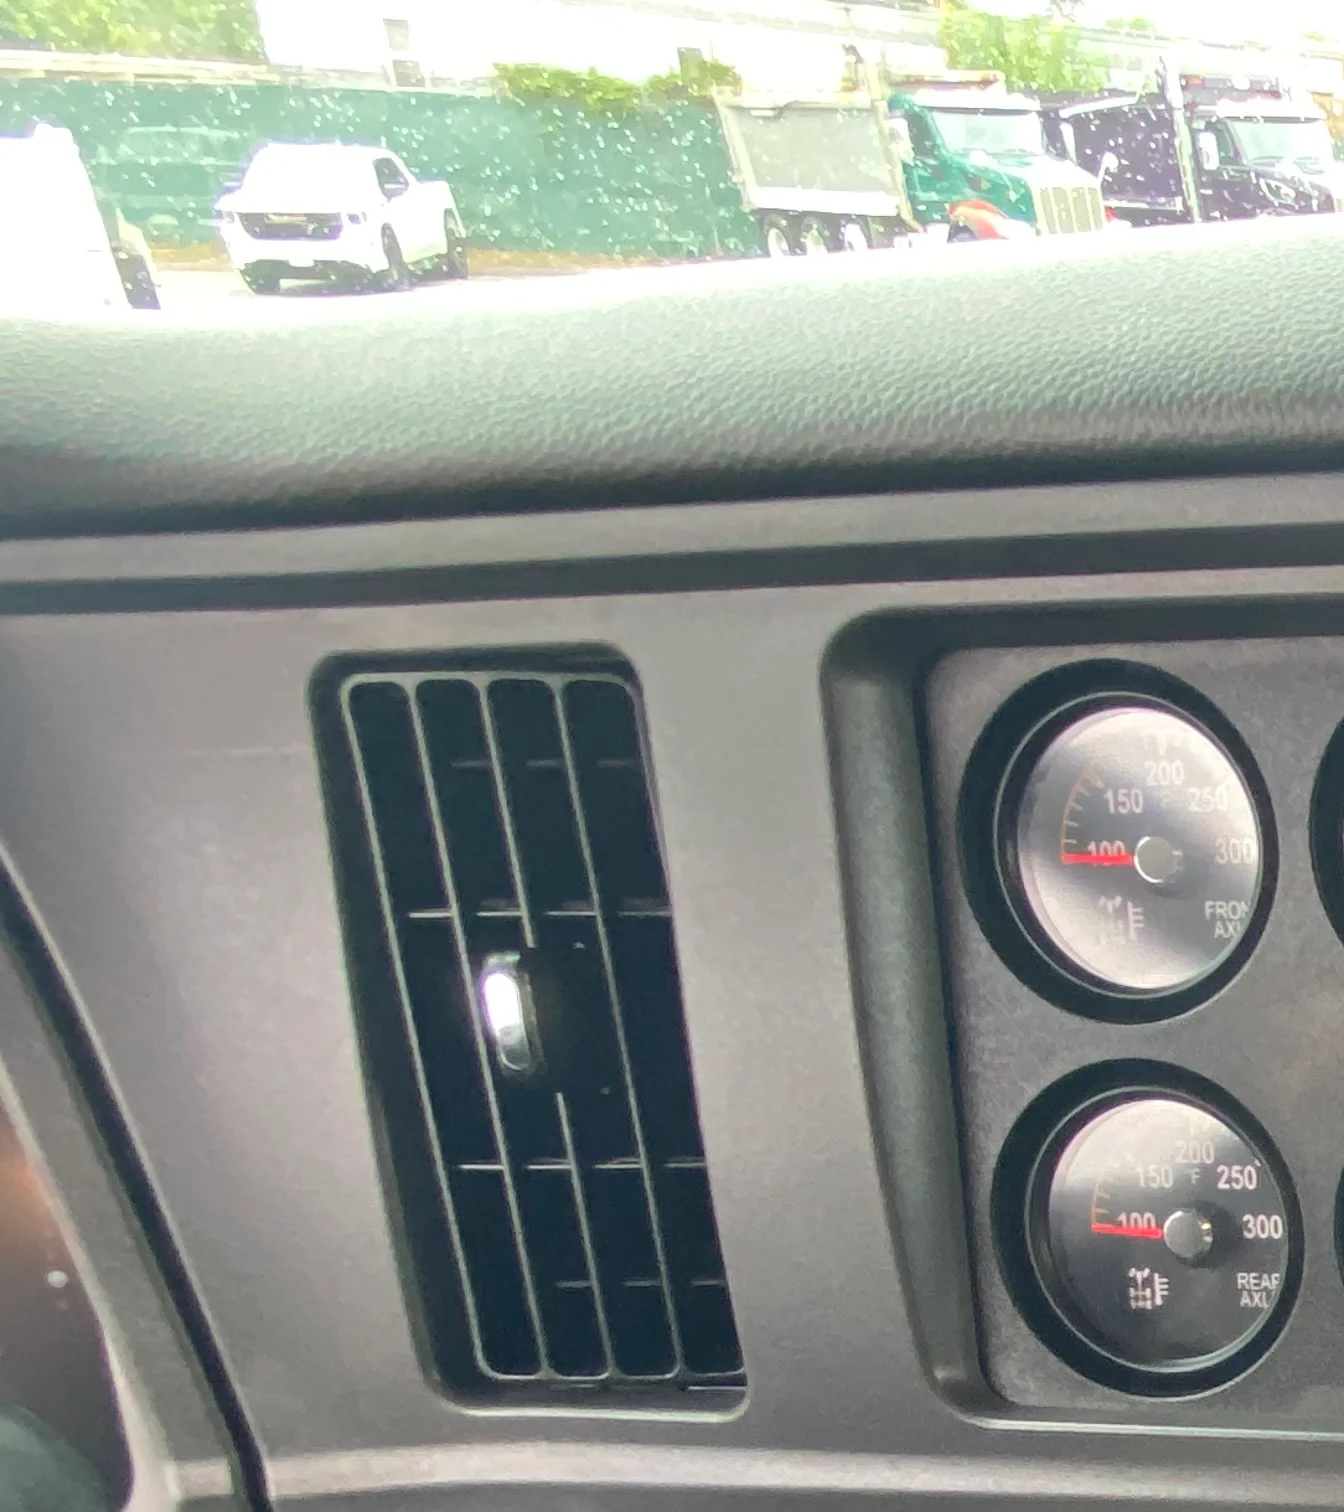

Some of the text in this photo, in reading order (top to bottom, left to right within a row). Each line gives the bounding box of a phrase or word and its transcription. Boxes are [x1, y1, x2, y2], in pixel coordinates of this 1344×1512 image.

[1144, 760, 1185, 785] 200
[1104, 789, 1143, 814] 150
[1188, 788, 1230, 812] 250
[1215, 838, 1256, 864] 300
[1175, 1140, 1215, 1164] 200
[1137, 1165, 1173, 1189] 150
[1216, 1165, 1258, 1190] 250
[1116, 1212, 1157, 1236] 100
[1242, 1214, 1283, 1240] 300
[1240, 1290, 1276, 1309] AXL
